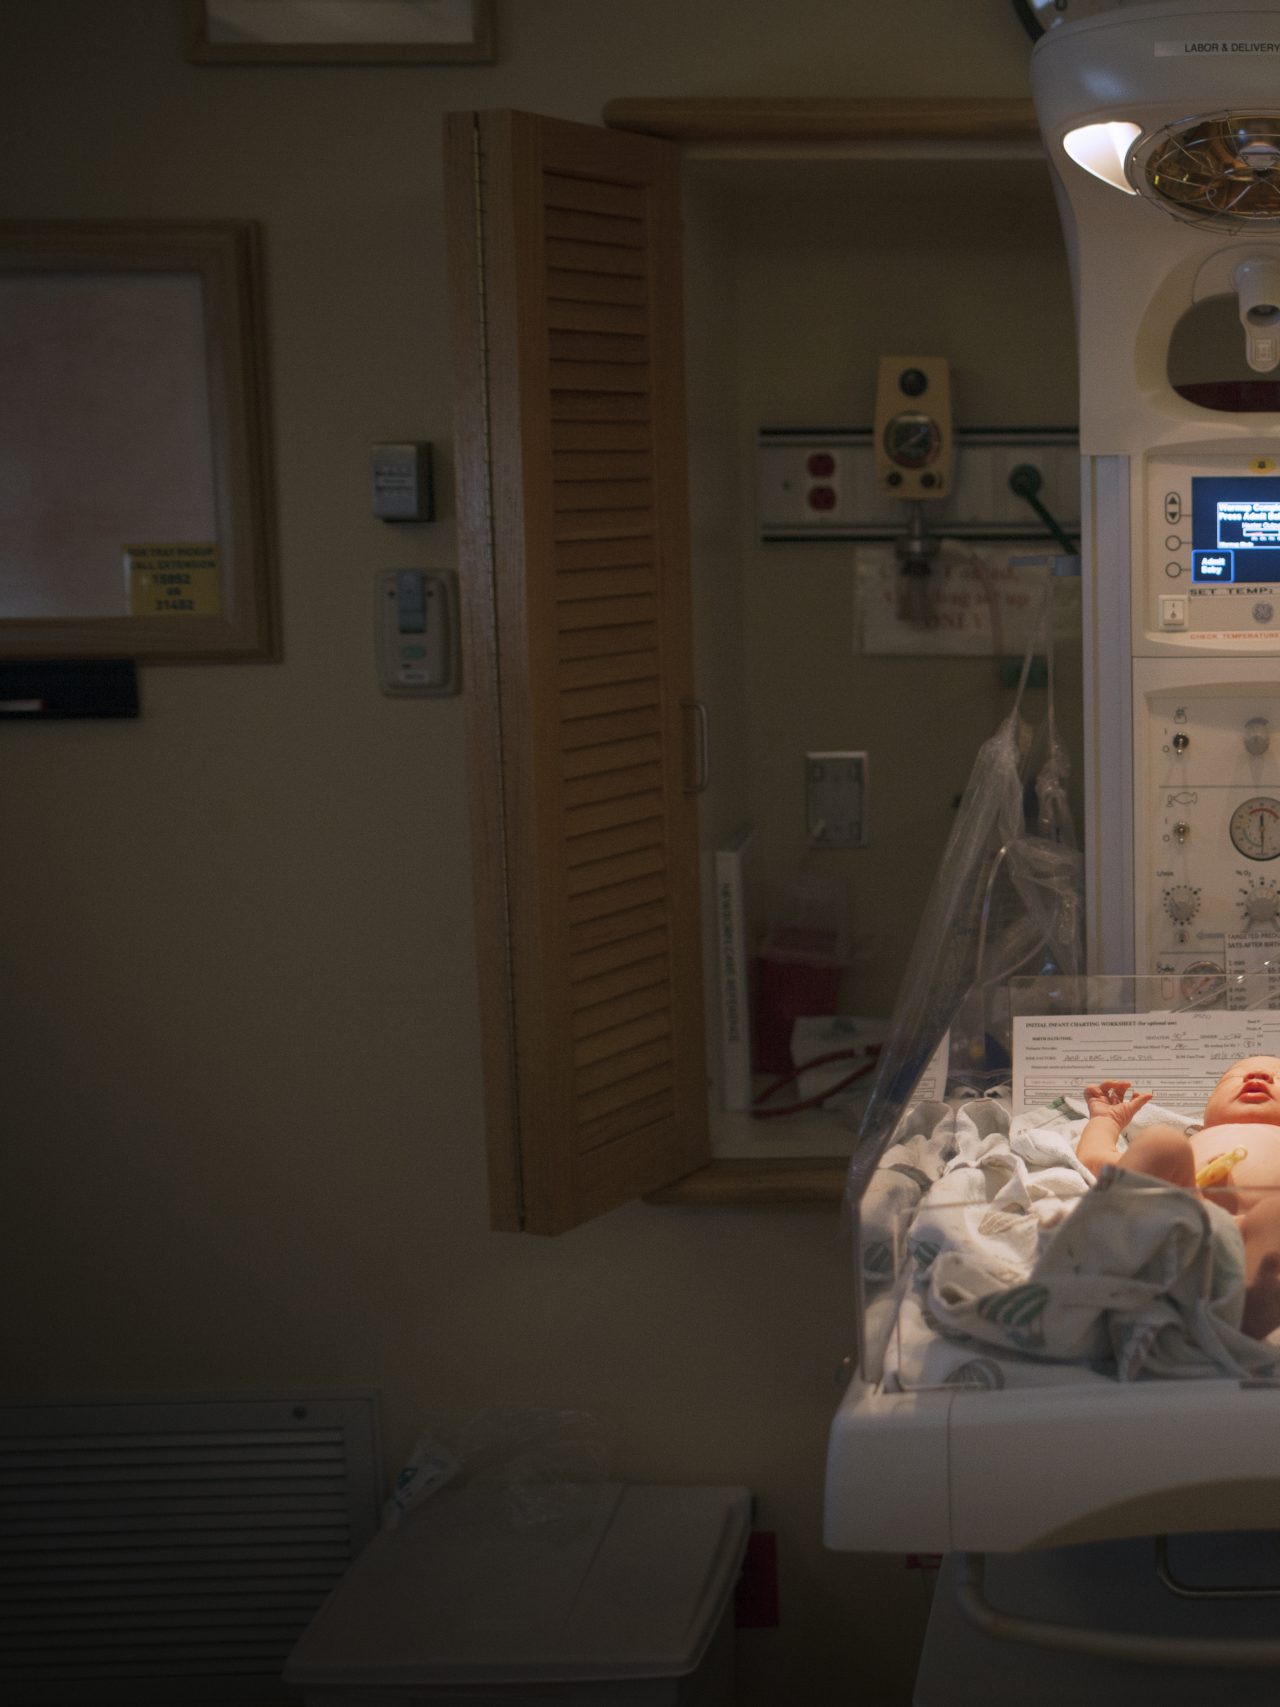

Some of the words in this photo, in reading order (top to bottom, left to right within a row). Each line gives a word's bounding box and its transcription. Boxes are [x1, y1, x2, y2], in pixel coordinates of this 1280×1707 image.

[1184, 43, 1219, 53] LABOR
[1221, 43, 1229, 52] &
[1231, 43, 1280, 52] DELIVERY
[1190, 588, 1216, 596] SET
[1228, 587, 1274, 595] TEMP:
